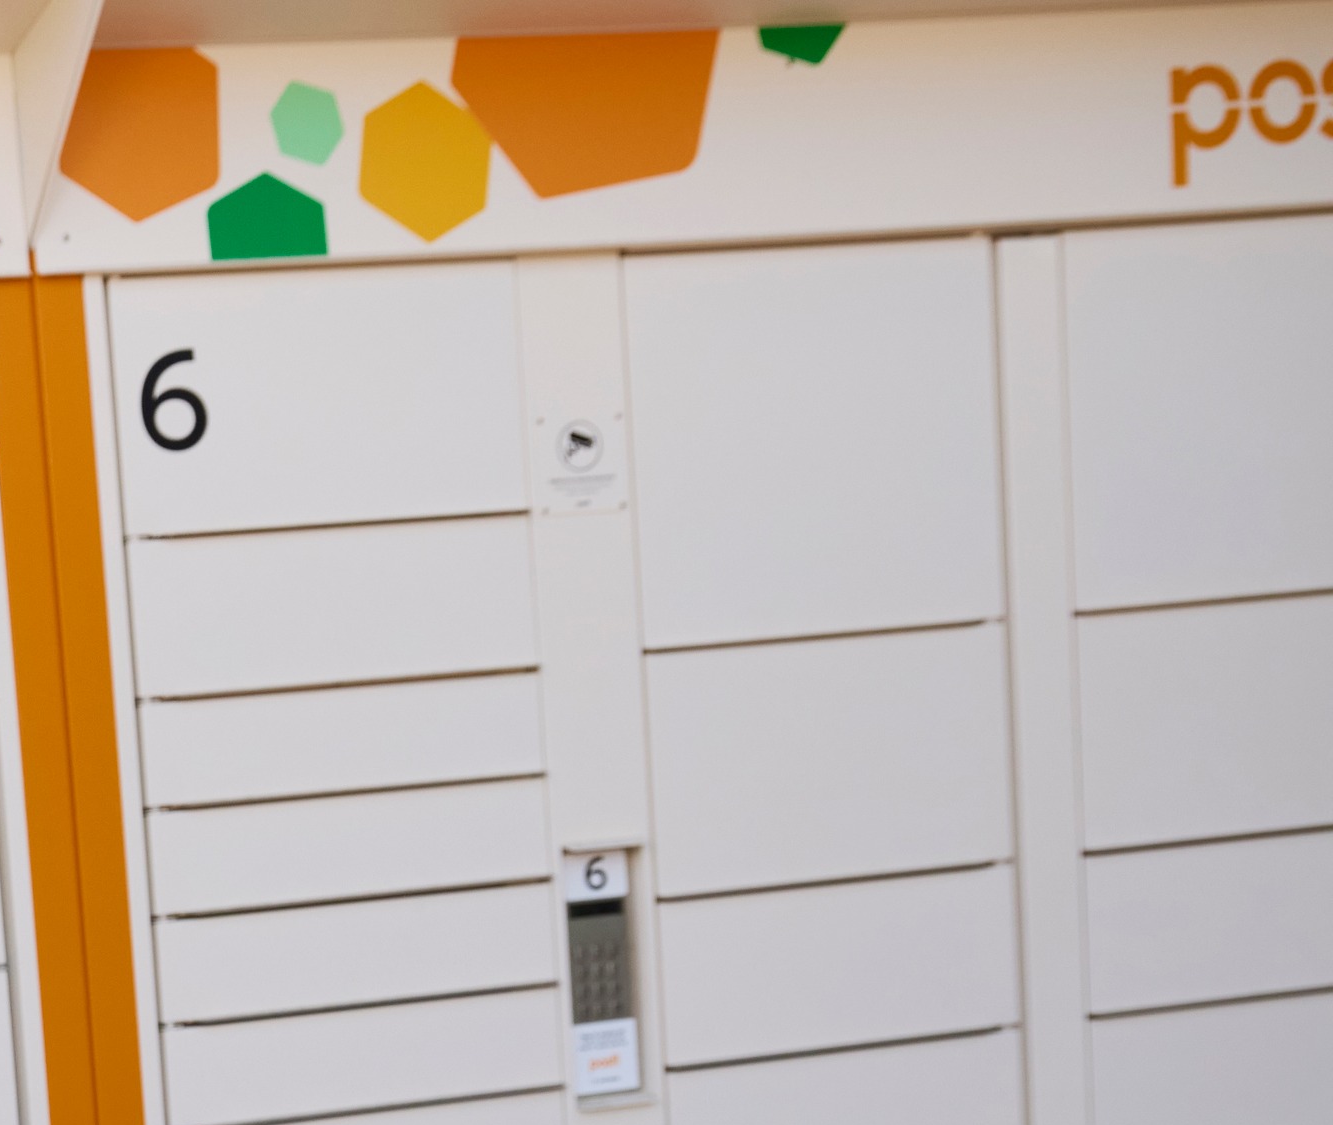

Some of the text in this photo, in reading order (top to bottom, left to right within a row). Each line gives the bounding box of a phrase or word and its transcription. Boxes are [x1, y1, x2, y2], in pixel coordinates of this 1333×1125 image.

[1170, 58, 1333, 187] po
[140, 348, 208, 452] 6
[585, 855, 608, 891] 6
